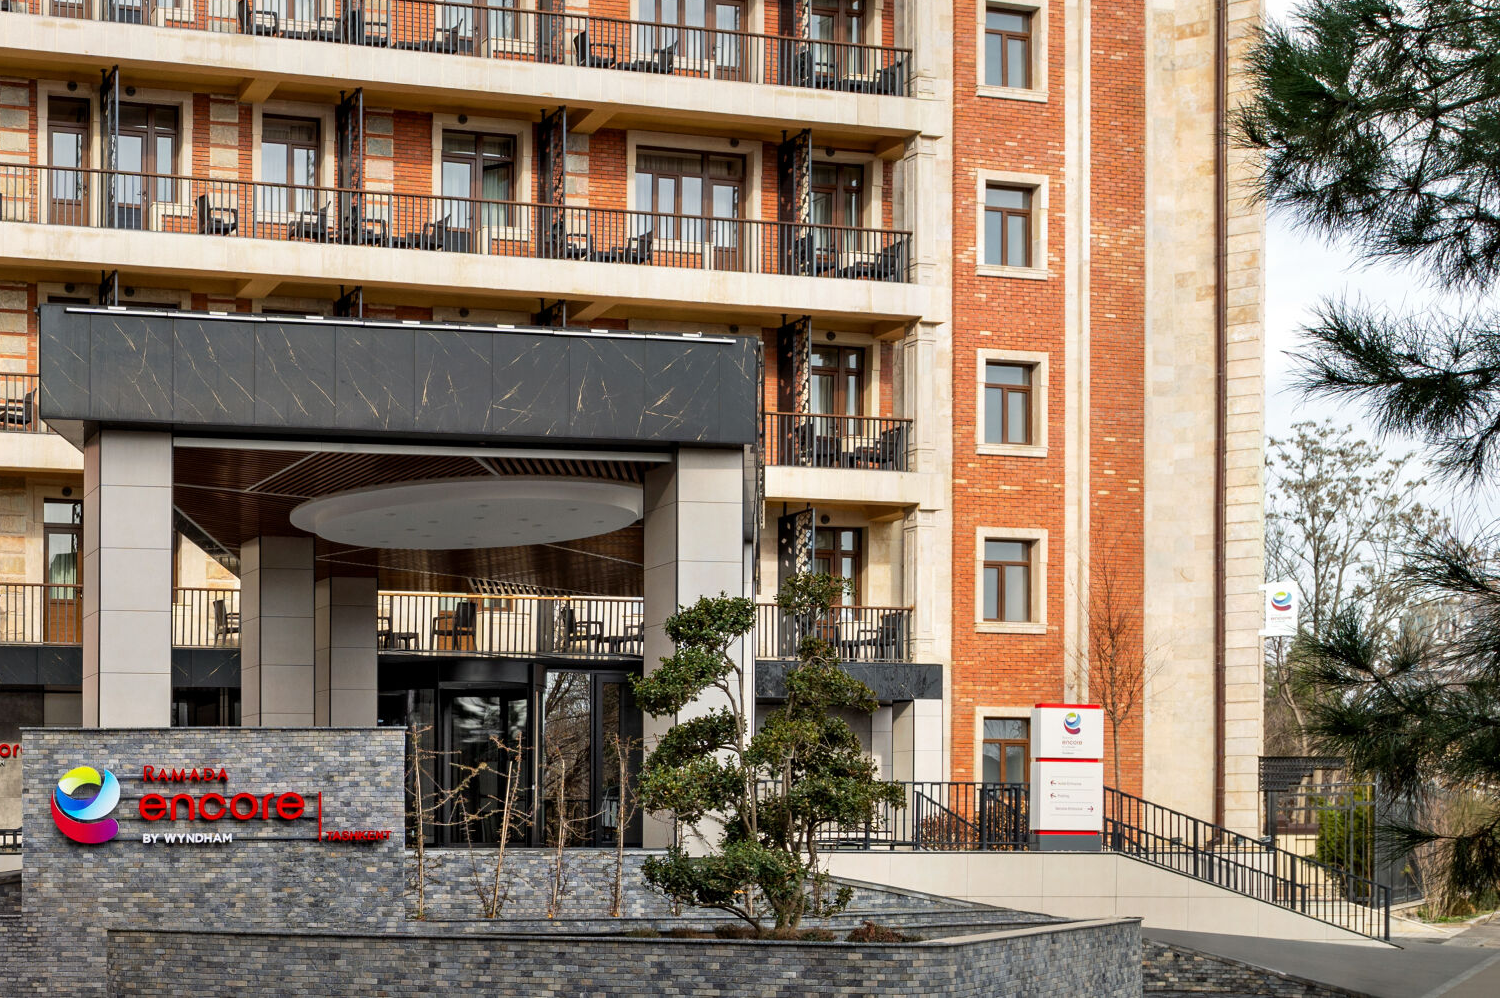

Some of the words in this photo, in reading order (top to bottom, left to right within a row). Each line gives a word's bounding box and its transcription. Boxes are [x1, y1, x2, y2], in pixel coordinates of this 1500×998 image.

[143, 765, 229, 782] RAMADA
[139, 792, 305, 821] encore
[142, 833, 160, 844] BY
[164, 832, 233, 844] WYNDHAM
[325, 830, 392, 841] TASHKENT
